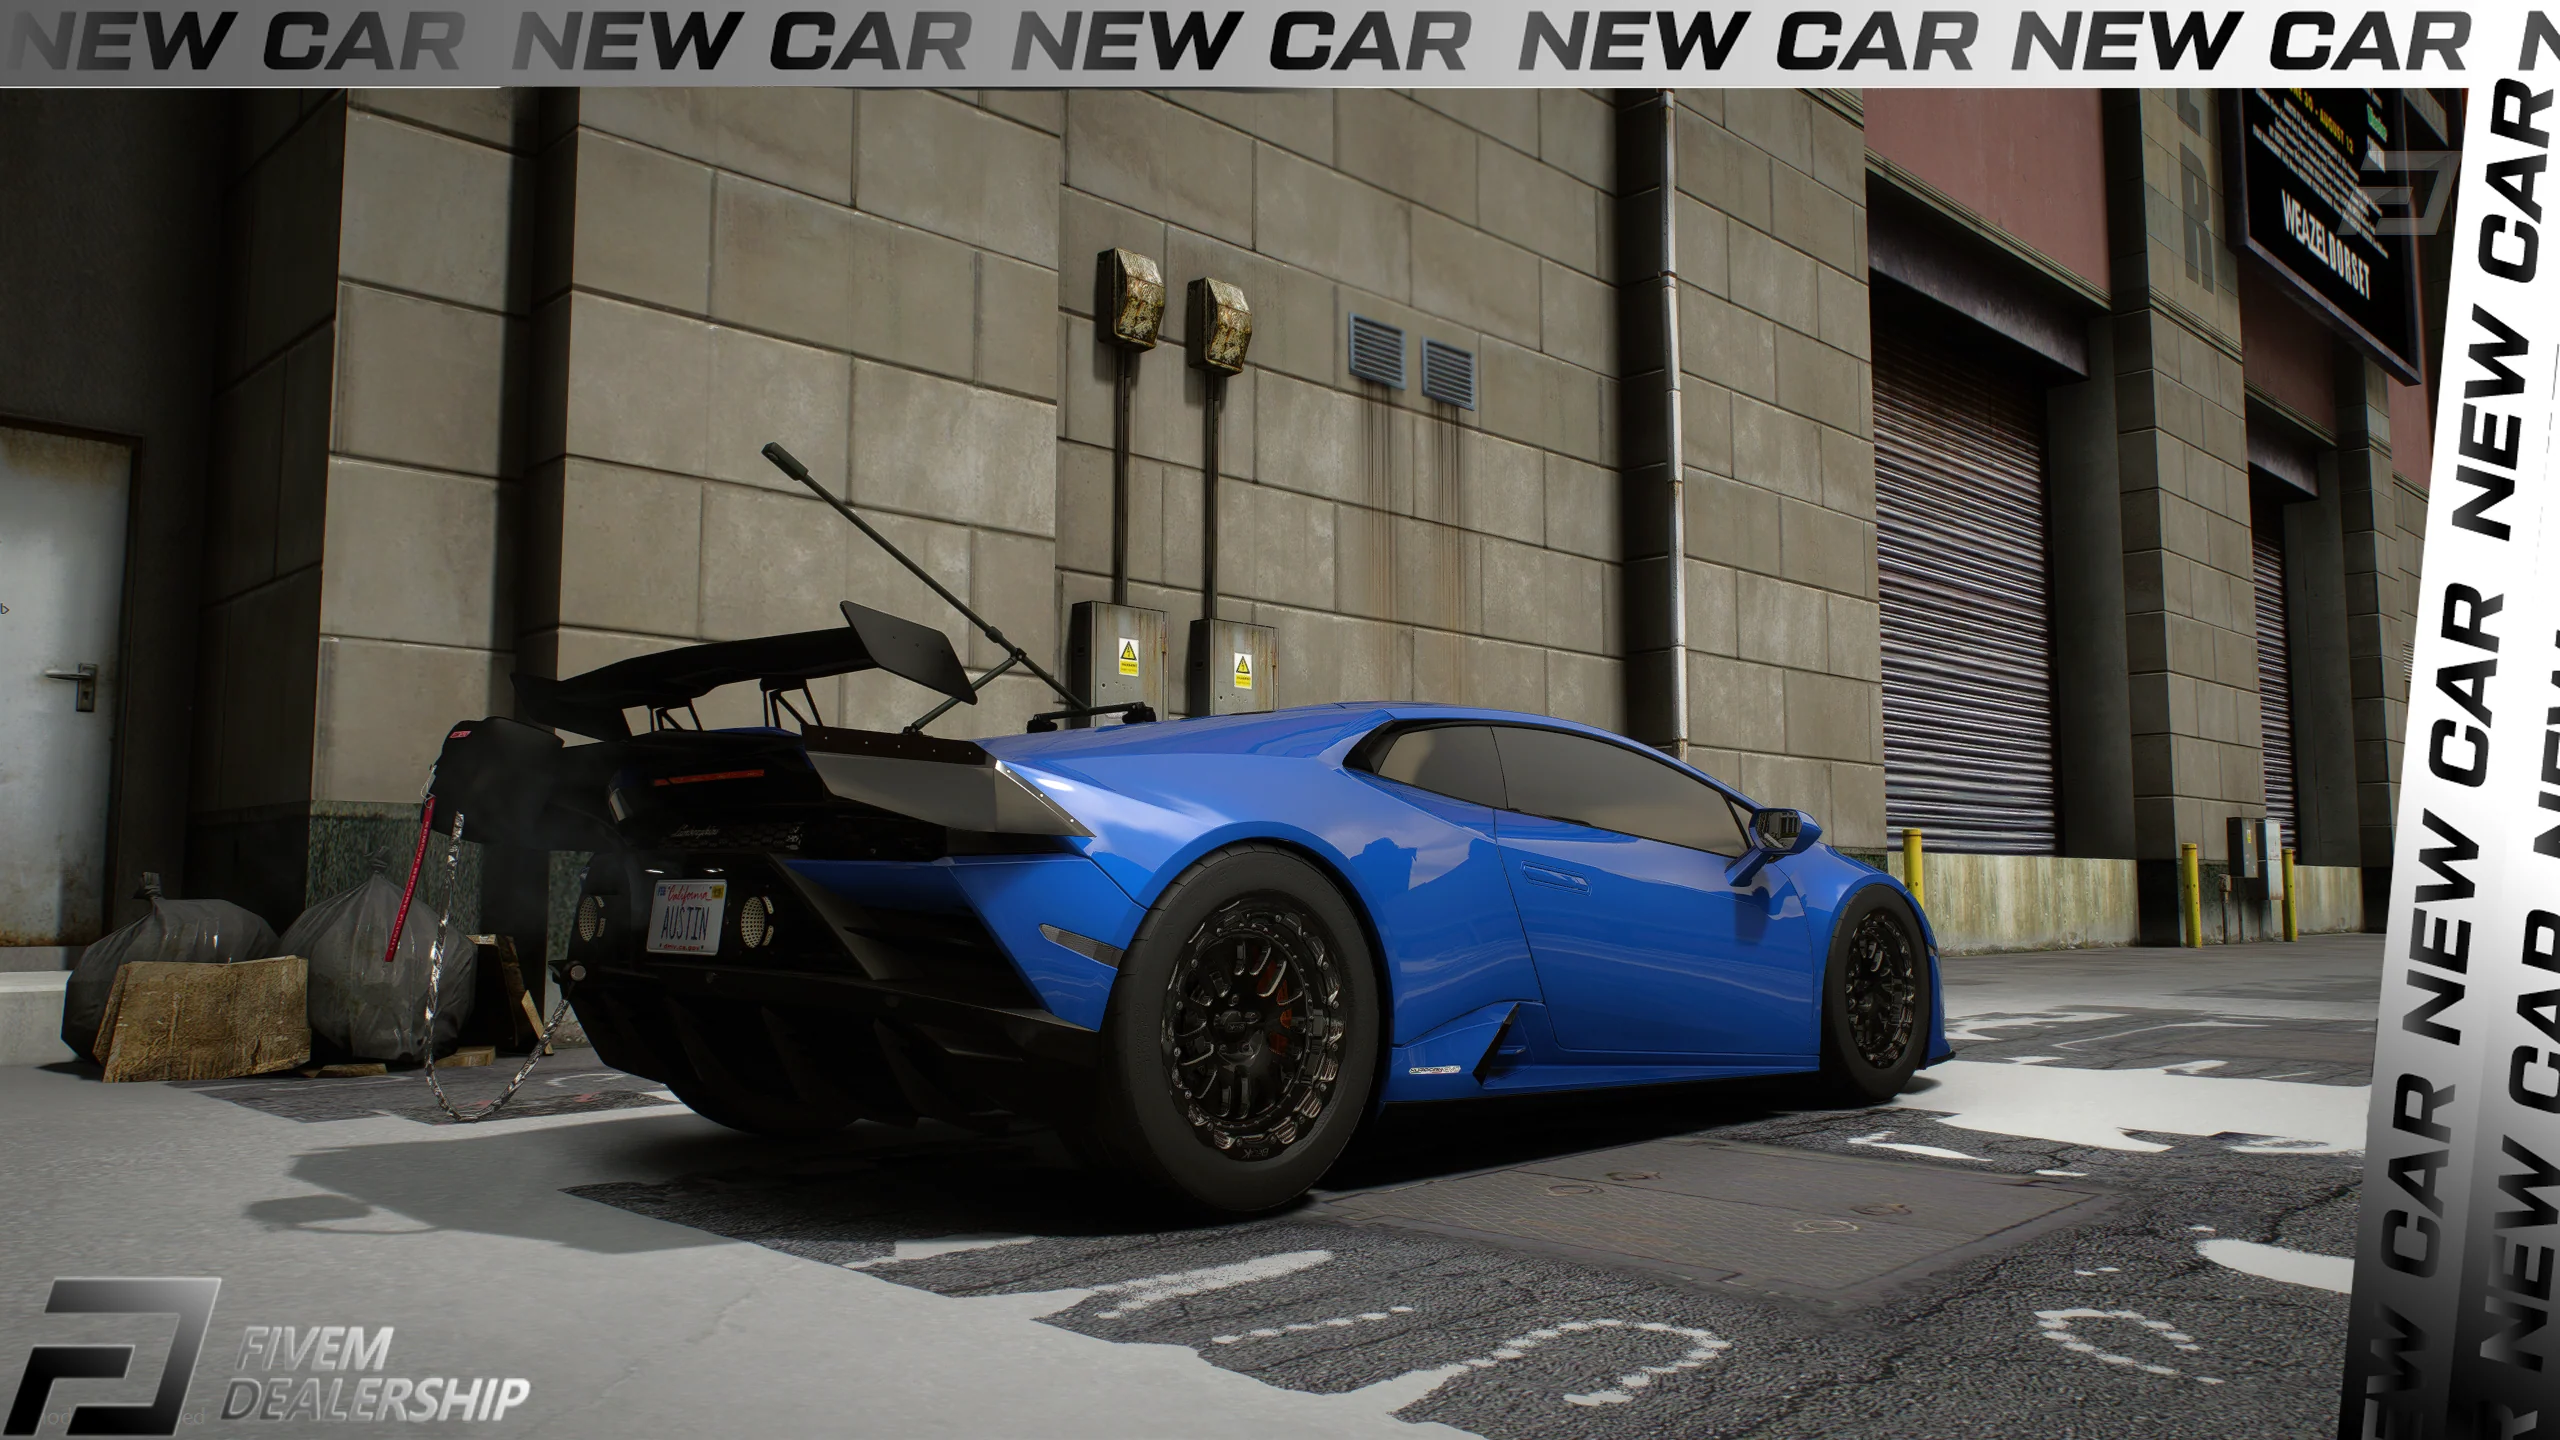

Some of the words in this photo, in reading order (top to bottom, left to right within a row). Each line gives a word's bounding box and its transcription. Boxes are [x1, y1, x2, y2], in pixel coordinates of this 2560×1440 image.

[2281, 188, 2329, 266] WEAZEL
[2327, 230, 2371, 302] DORSET
[668, 885, 712, 905] California
[661, 906, 710, 941] AUSTIN
